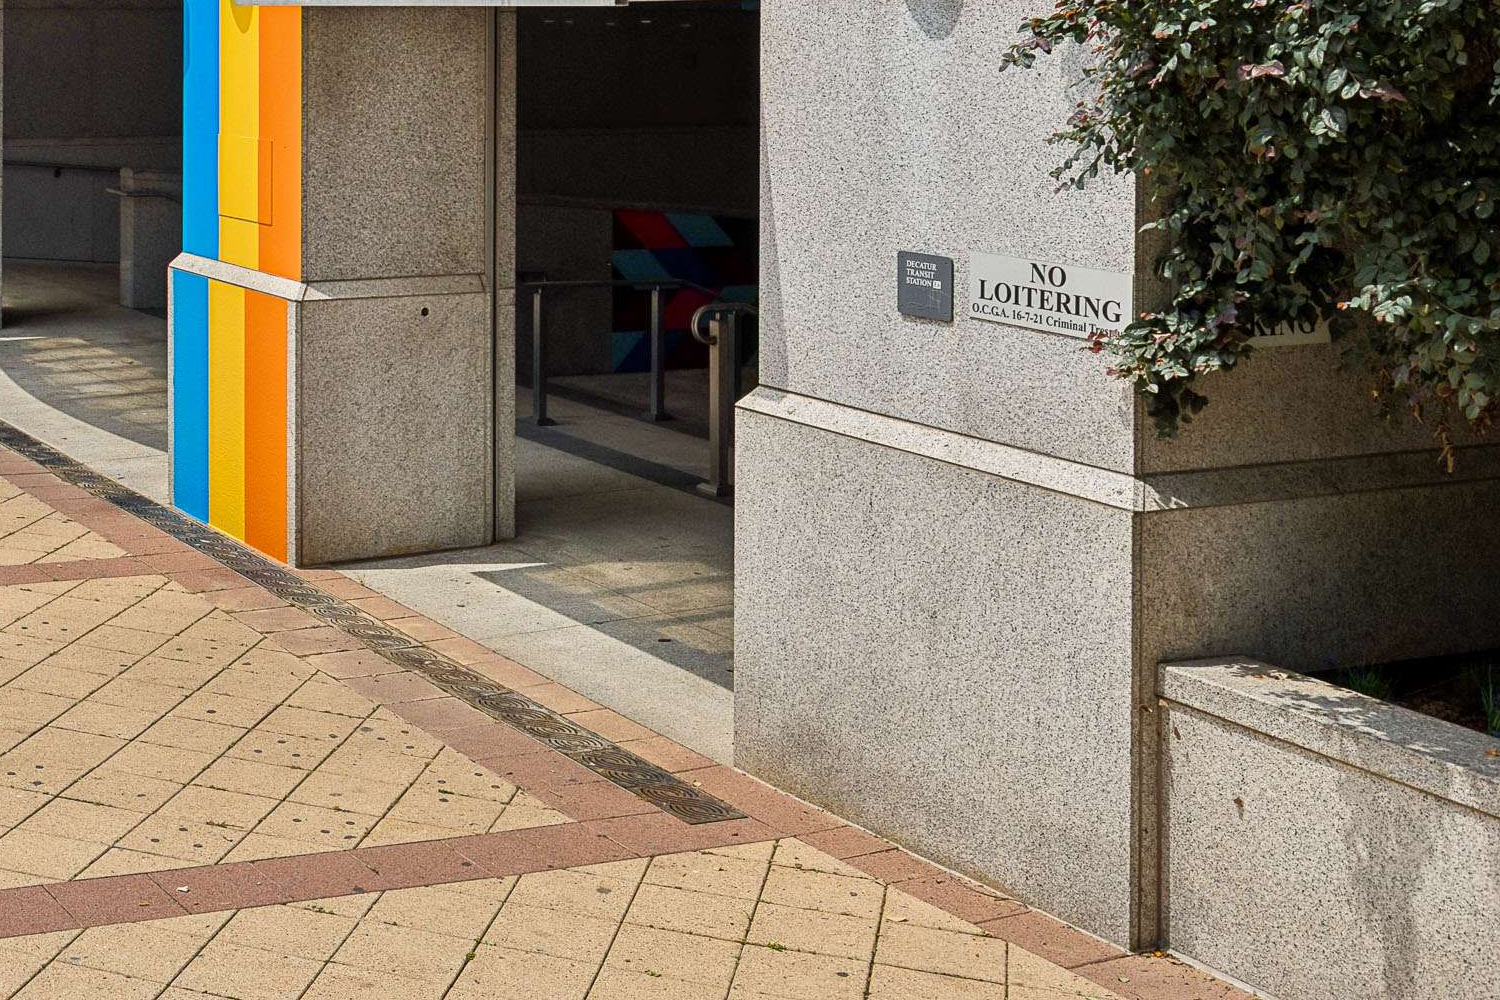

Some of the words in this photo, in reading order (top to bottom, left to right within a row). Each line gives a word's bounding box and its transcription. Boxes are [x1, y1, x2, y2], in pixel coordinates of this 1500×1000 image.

[906, 260, 937, 271] DECATUR
[906, 268, 935, 279] TRANSIT
[906, 277, 932, 287] STATION
[1030, 262, 1067, 288] NO
[978, 278, 1122, 323] LOITERING
[972, 302, 1010, 318] O.C.G.A.
[1012, 309, 1043, 325] 16-7-21
[1046, 316, 1087, 333] Criminal
